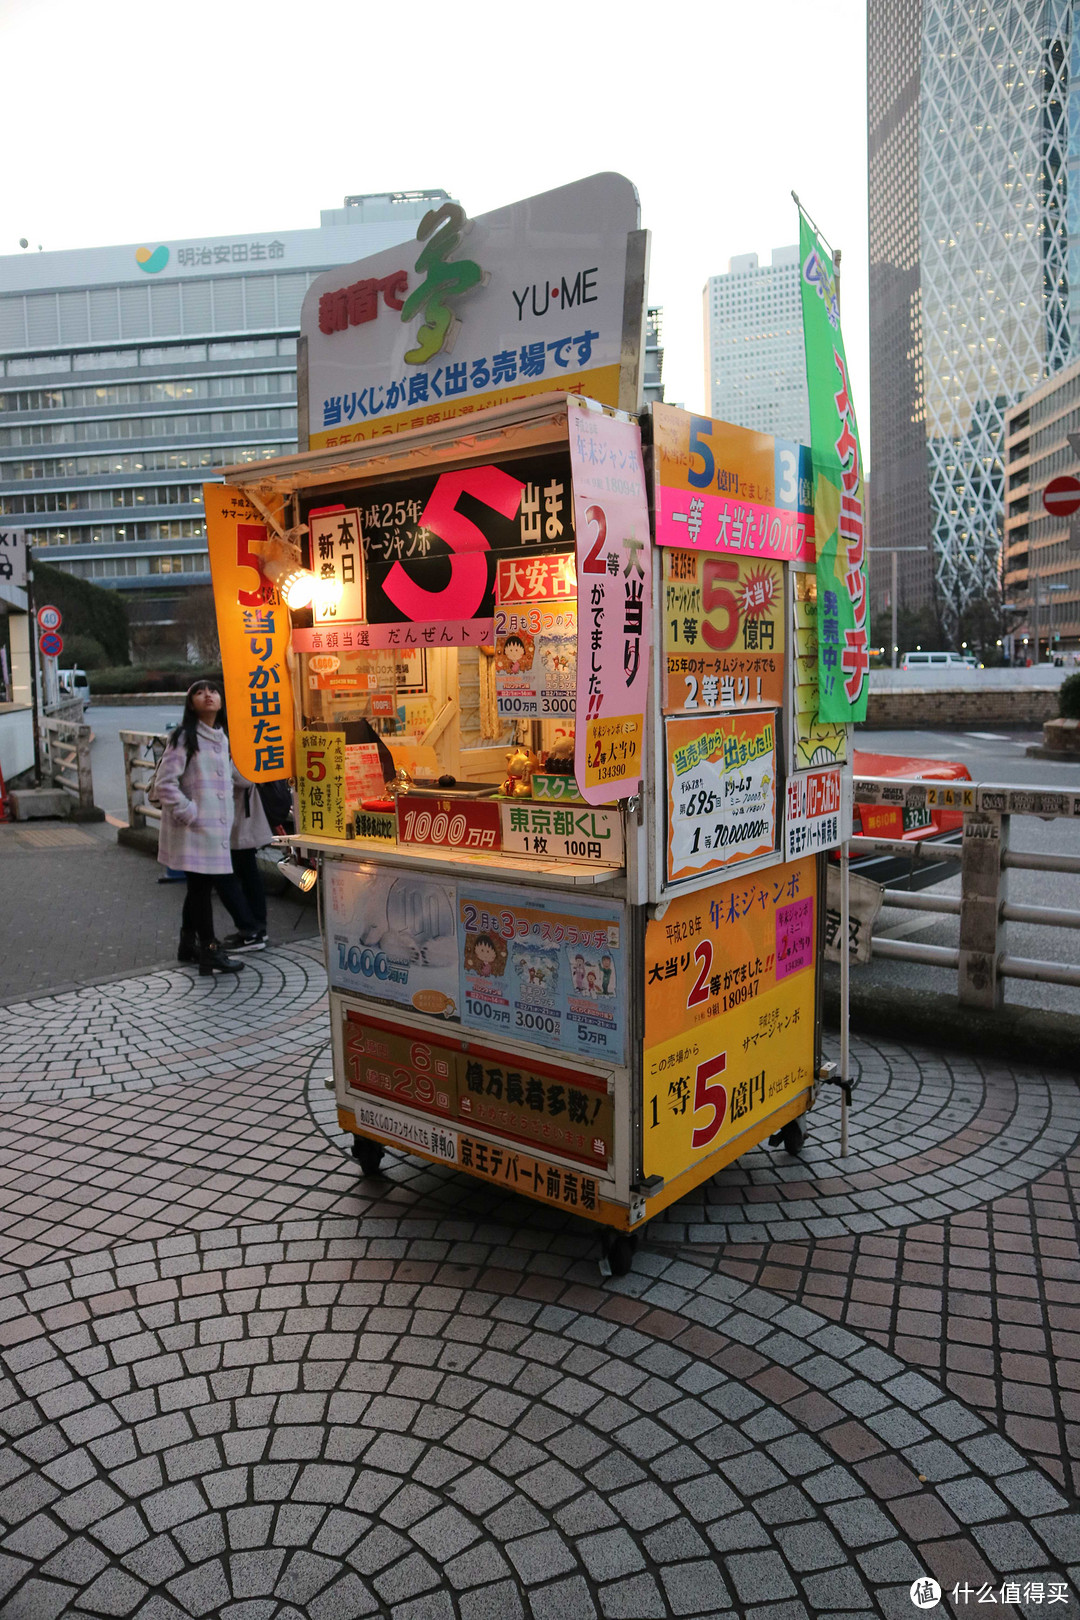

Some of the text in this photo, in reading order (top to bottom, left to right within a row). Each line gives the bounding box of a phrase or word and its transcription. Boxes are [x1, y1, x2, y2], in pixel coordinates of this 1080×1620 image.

[178, 240, 285, 266] 明治安田生命
[318, 269, 409, 335] 新宿で
[323, 330, 600, 426] 当りくじが良く出る売場です
[672, 497, 704, 543] 一等
[337, 517, 355, 584] 本日
[622, 525, 645, 688] 大当り
[742, 579, 774, 610] 大当り
[43, 612, 57, 625] 40
[311, 631, 370, 649] 高額当選
[243, 608, 285, 773] 当りが出た店
[497, 698, 538, 712] 100万円
[674, 725, 773, 772] 当売場から 出ました!!
[597, 762, 626, 781] 134390
[509, 807, 611, 840] 東京都くじ
[965, 824, 999, 839] DAVE
[523, 835, 602, 859] 1枚 100円
[665, 872, 801, 945] 平成28年 年末ジャンボ
[463, 904, 609, 950] 2月も3つのスクラッチ
[465, 999, 511, 1023] 100万円
[722, 979, 760, 1013] 180947
[577, 1025, 607, 1047] 5万円
[742, 1007, 801, 1054] サマージャンボ
[650, 1043, 701, 1076] この売場から
[465, 1059, 602, 1127] 億万長者多数!
[360, 1108, 429, 1146] あの宝くじのファンサイトでも
[460, 1138, 596, 1210] 京王デパート前売場
